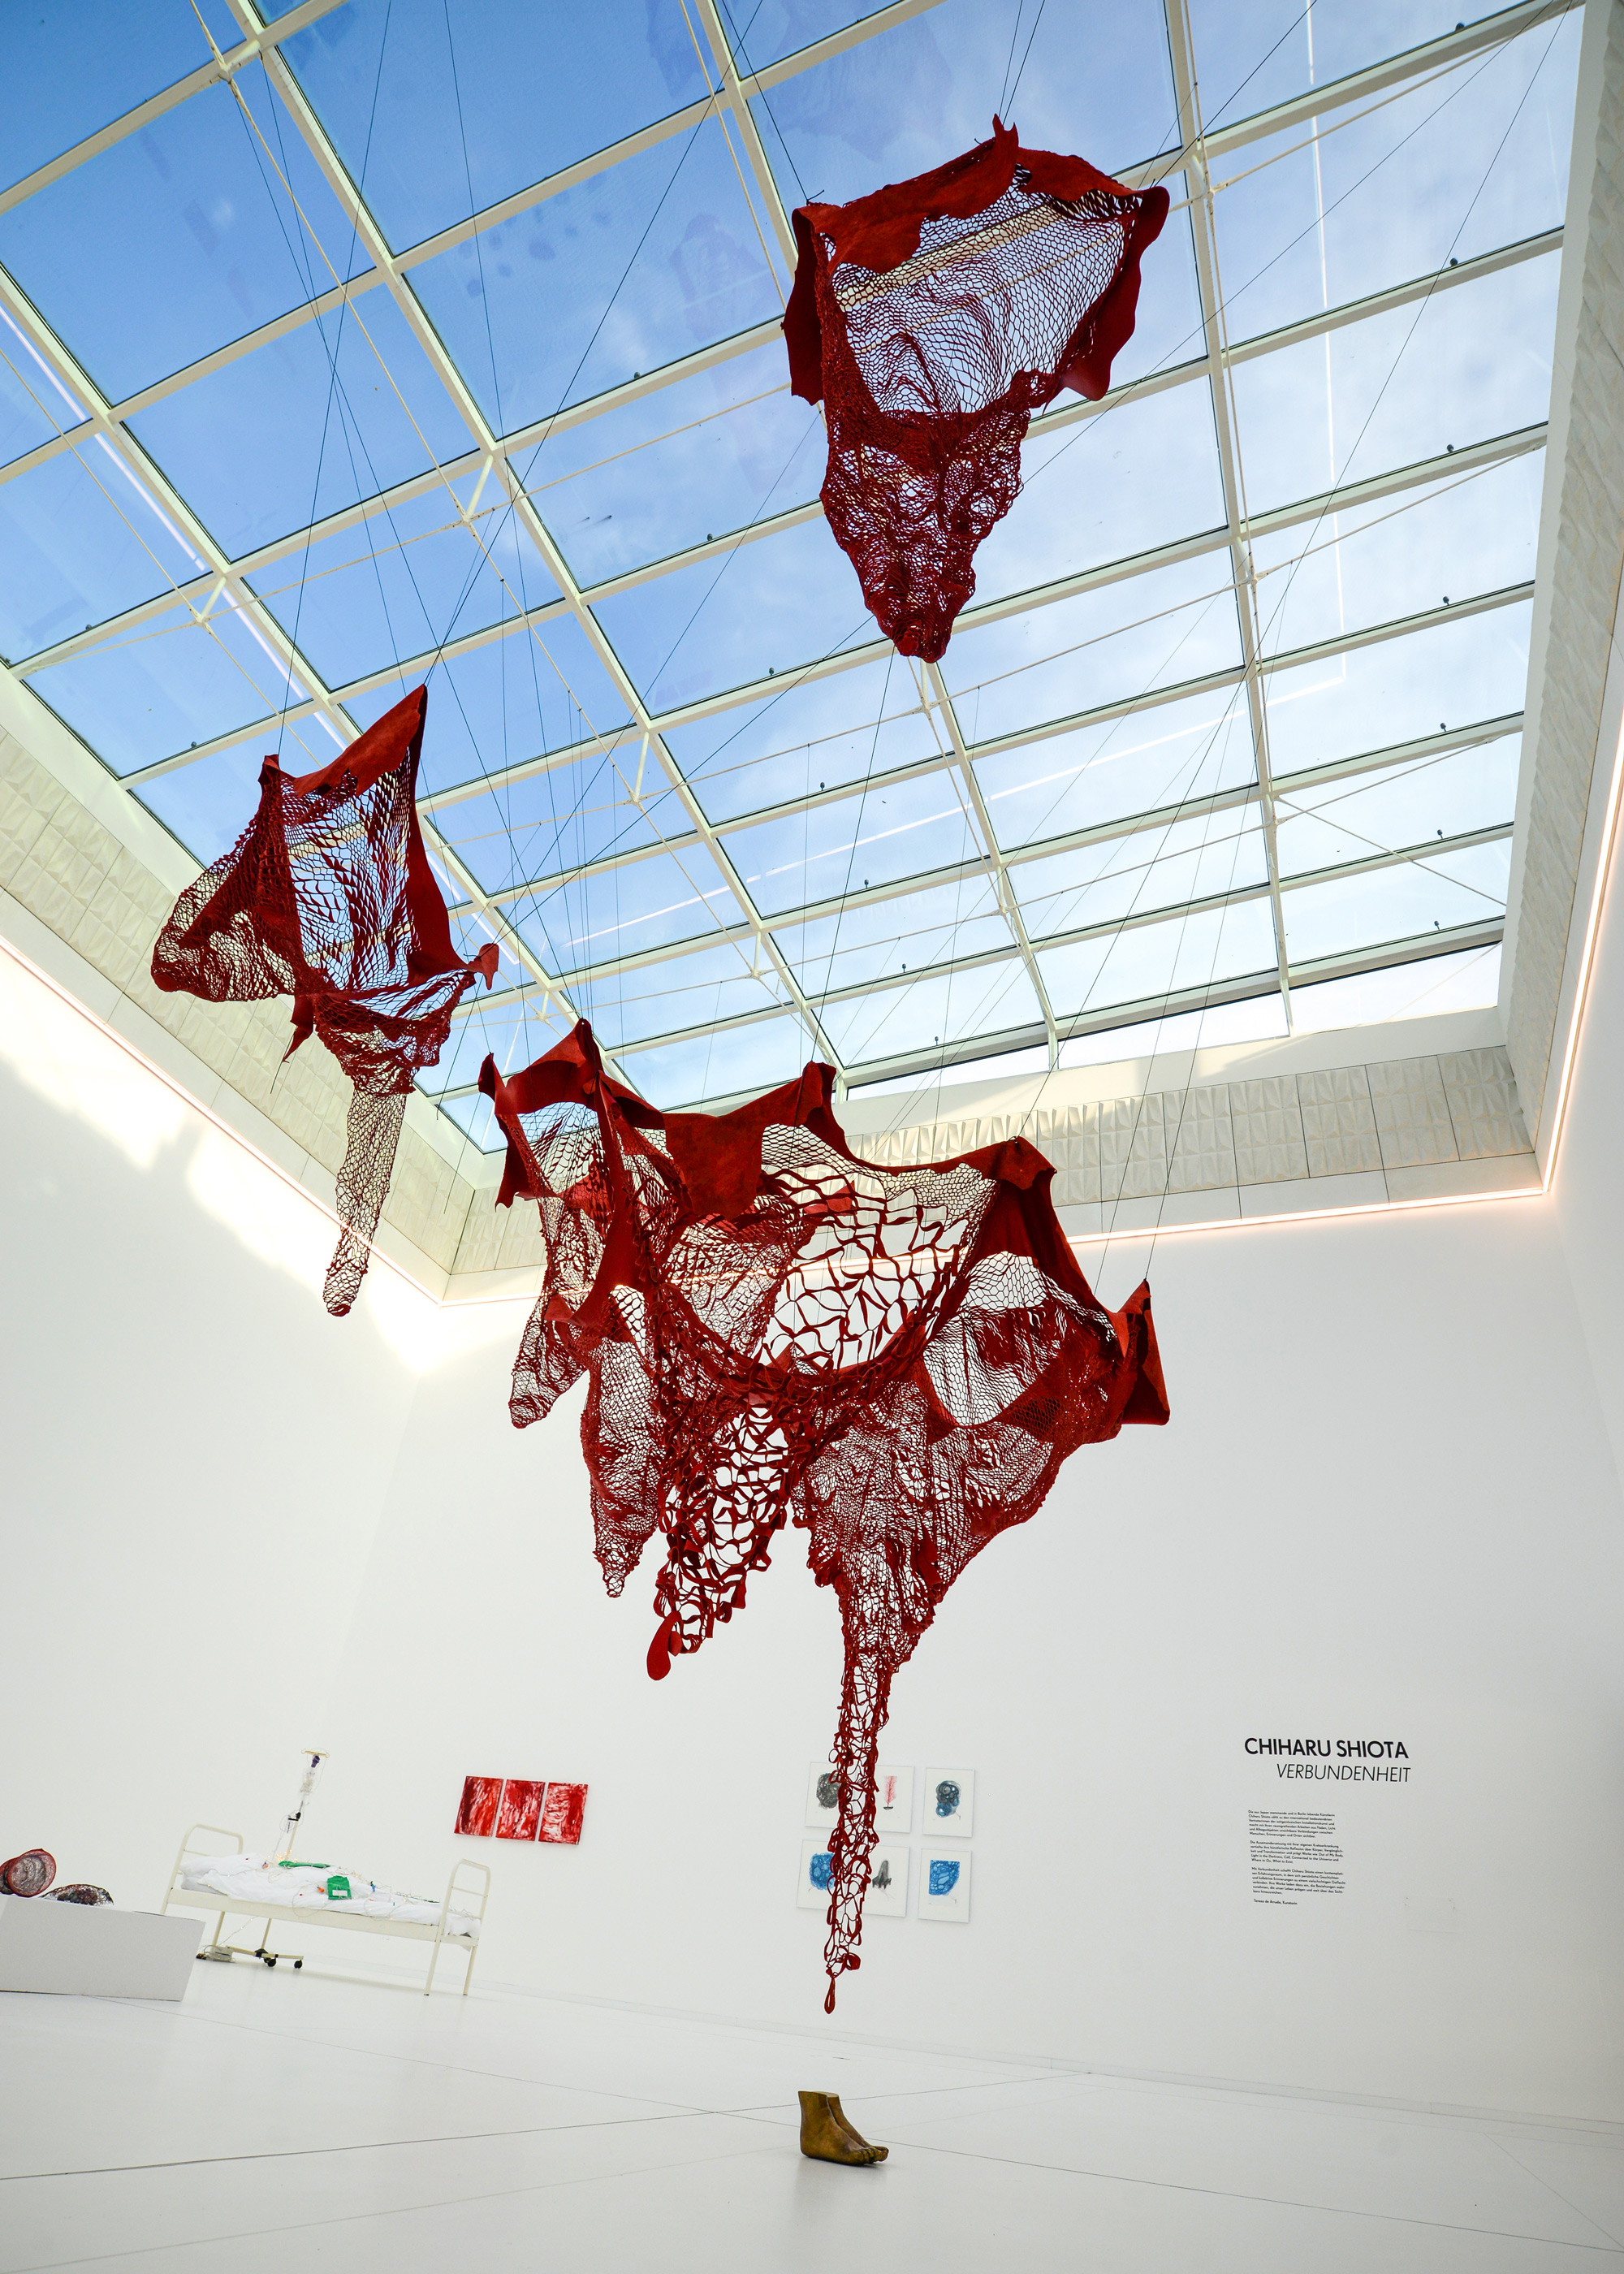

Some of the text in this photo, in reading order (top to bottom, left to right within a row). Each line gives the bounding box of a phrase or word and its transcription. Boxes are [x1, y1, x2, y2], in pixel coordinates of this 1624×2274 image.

[1244, 1738, 1409, 1759] CHIHARU SHIOTA
[1276, 1763, 1411, 1782] VERBUNDENHEIT
